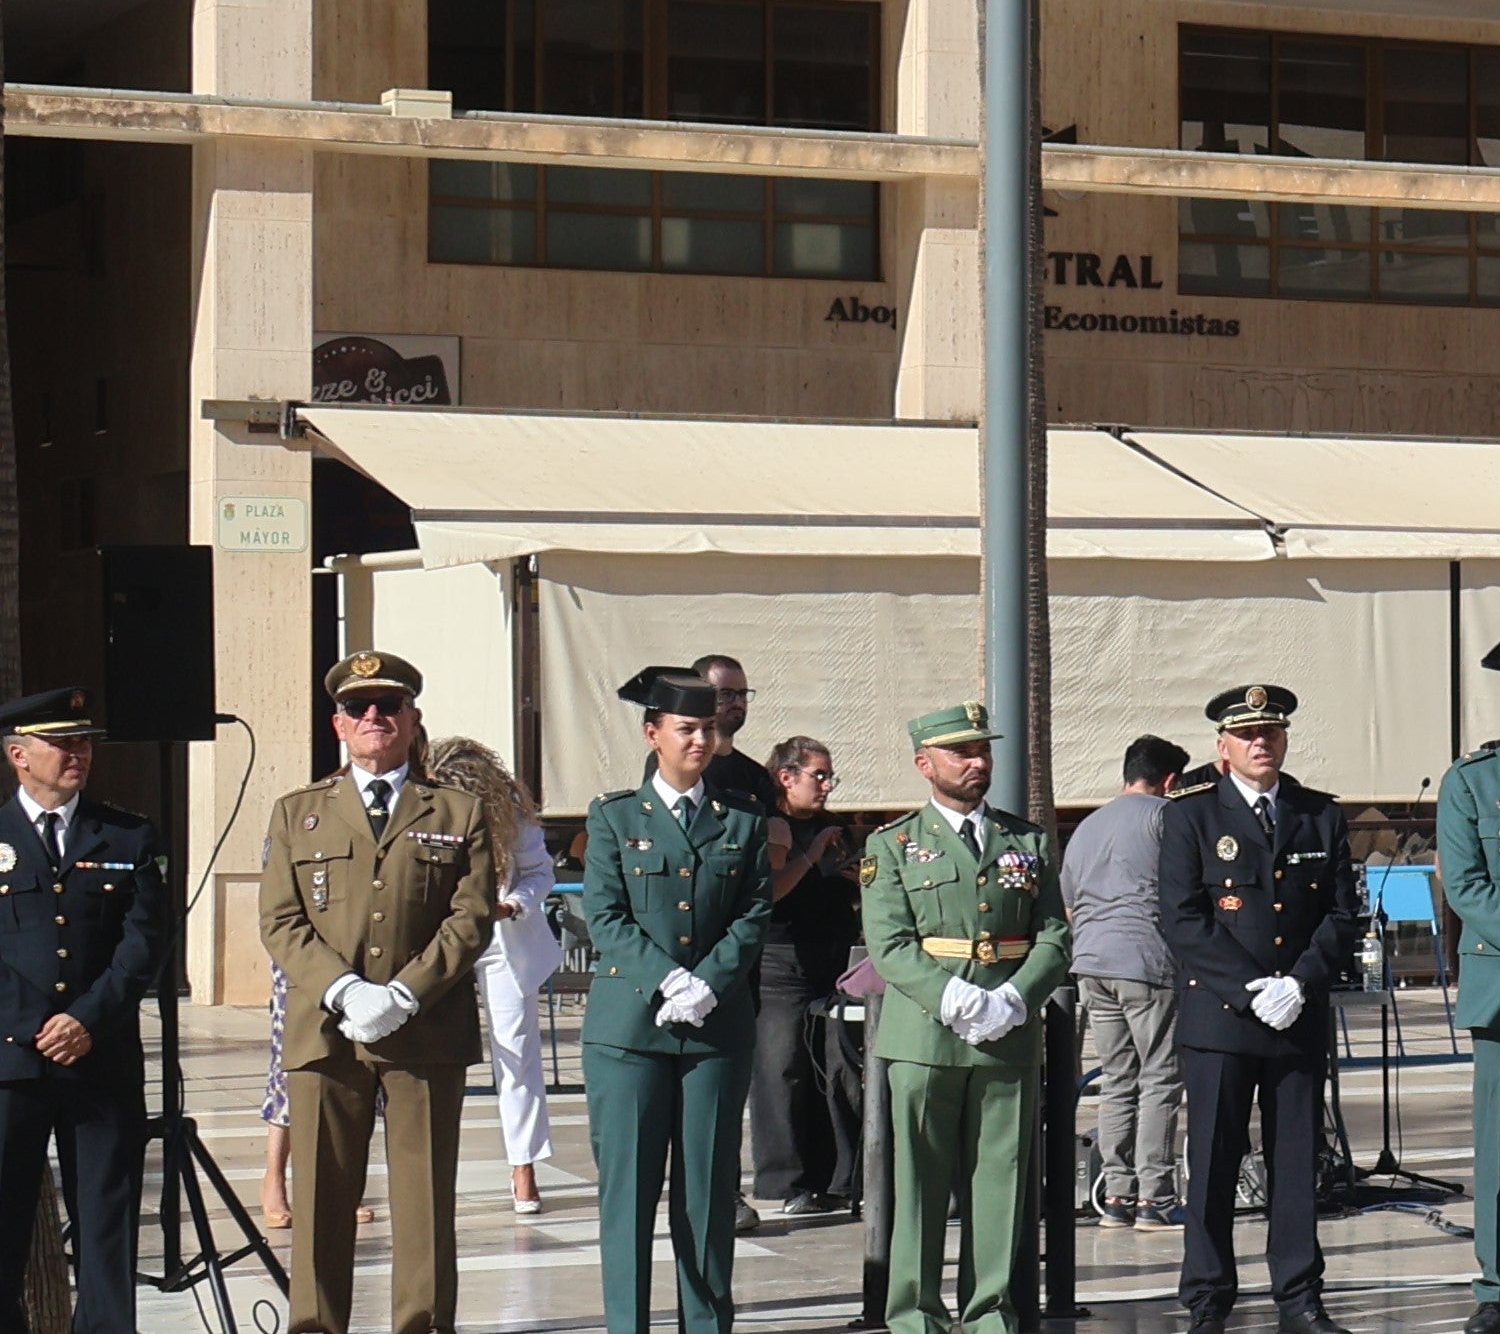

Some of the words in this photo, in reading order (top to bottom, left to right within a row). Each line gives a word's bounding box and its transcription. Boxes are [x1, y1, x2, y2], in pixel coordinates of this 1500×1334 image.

[1044, 251, 1163, 289] TRAL
[1044, 305, 1240, 337] Economistas
[245, 504, 285, 518] PLAZA
[239, 530, 291, 545] MAYOR
